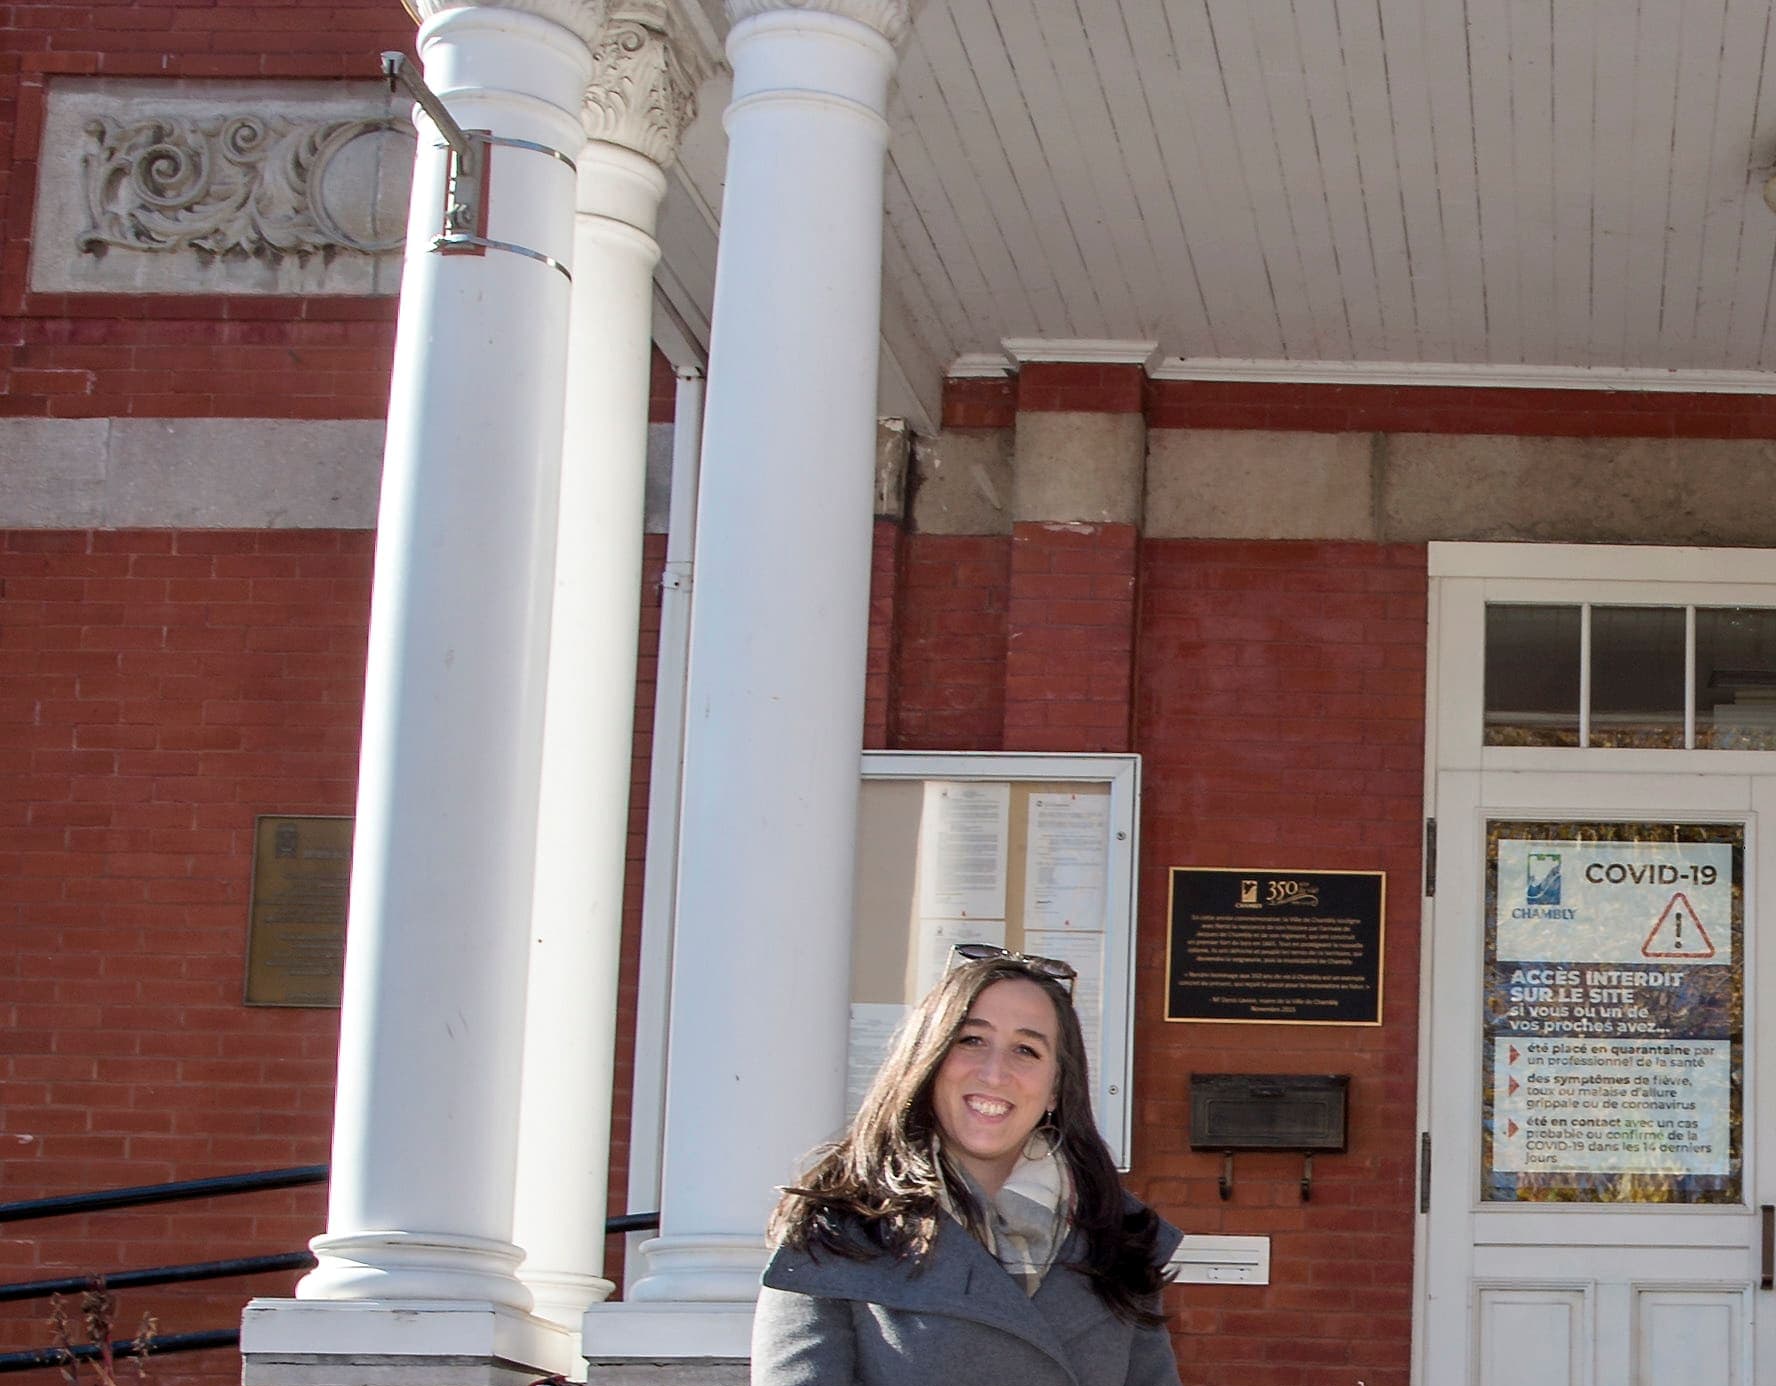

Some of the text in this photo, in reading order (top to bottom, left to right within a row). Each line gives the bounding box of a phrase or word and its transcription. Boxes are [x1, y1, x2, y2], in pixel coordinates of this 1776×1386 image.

[1585, 863, 1717, 885] COVID-19
[1266, 880, 1298, 900] 350
[1512, 908, 1576, 920] CHAMBLY
[1511, 967, 1684, 987] ACCÈS INTERDIT
[1510, 987, 1634, 1003] SUR LE SITE
[1510, 1004, 1649, 1018] si vous ou un de
[1510, 1020, 1540, 1031] vos
[1543, 1018, 1614, 1034] proches
[1527, 1043, 1715, 1058] été placé en quarantaine par
[1528, 1055, 1705, 1068] un professionnel de la santé
[1527, 1073, 1549, 1084] des
[1553, 1074, 1630, 1088] symptômes
[1634, 1075, 1650, 1085] de
[1527, 1086, 1554, 1096] toux
[1558, 1088, 1574, 1096] ou
[1578, 1086, 1628, 1097] malaise
[1526, 1098, 1696, 1111] grippale ou de coronavirus
[1526, 1116, 1698, 1129] été en contact avec un cas
[1526, 1128, 1583, 1140] probable
[1586, 1131, 1601, 1140] ou
[1667, 1129, 1684, 1141] de
[1687, 1130, 1698, 1141] la
[1525, 1140, 1585, 1152] COVID-19
[1588, 1141, 1619, 1152] dans
[1622, 1141, 1640, 1152] les
[1659, 1142, 1712, 1154] derniers
[1524, 1153, 1558, 1165] jours
